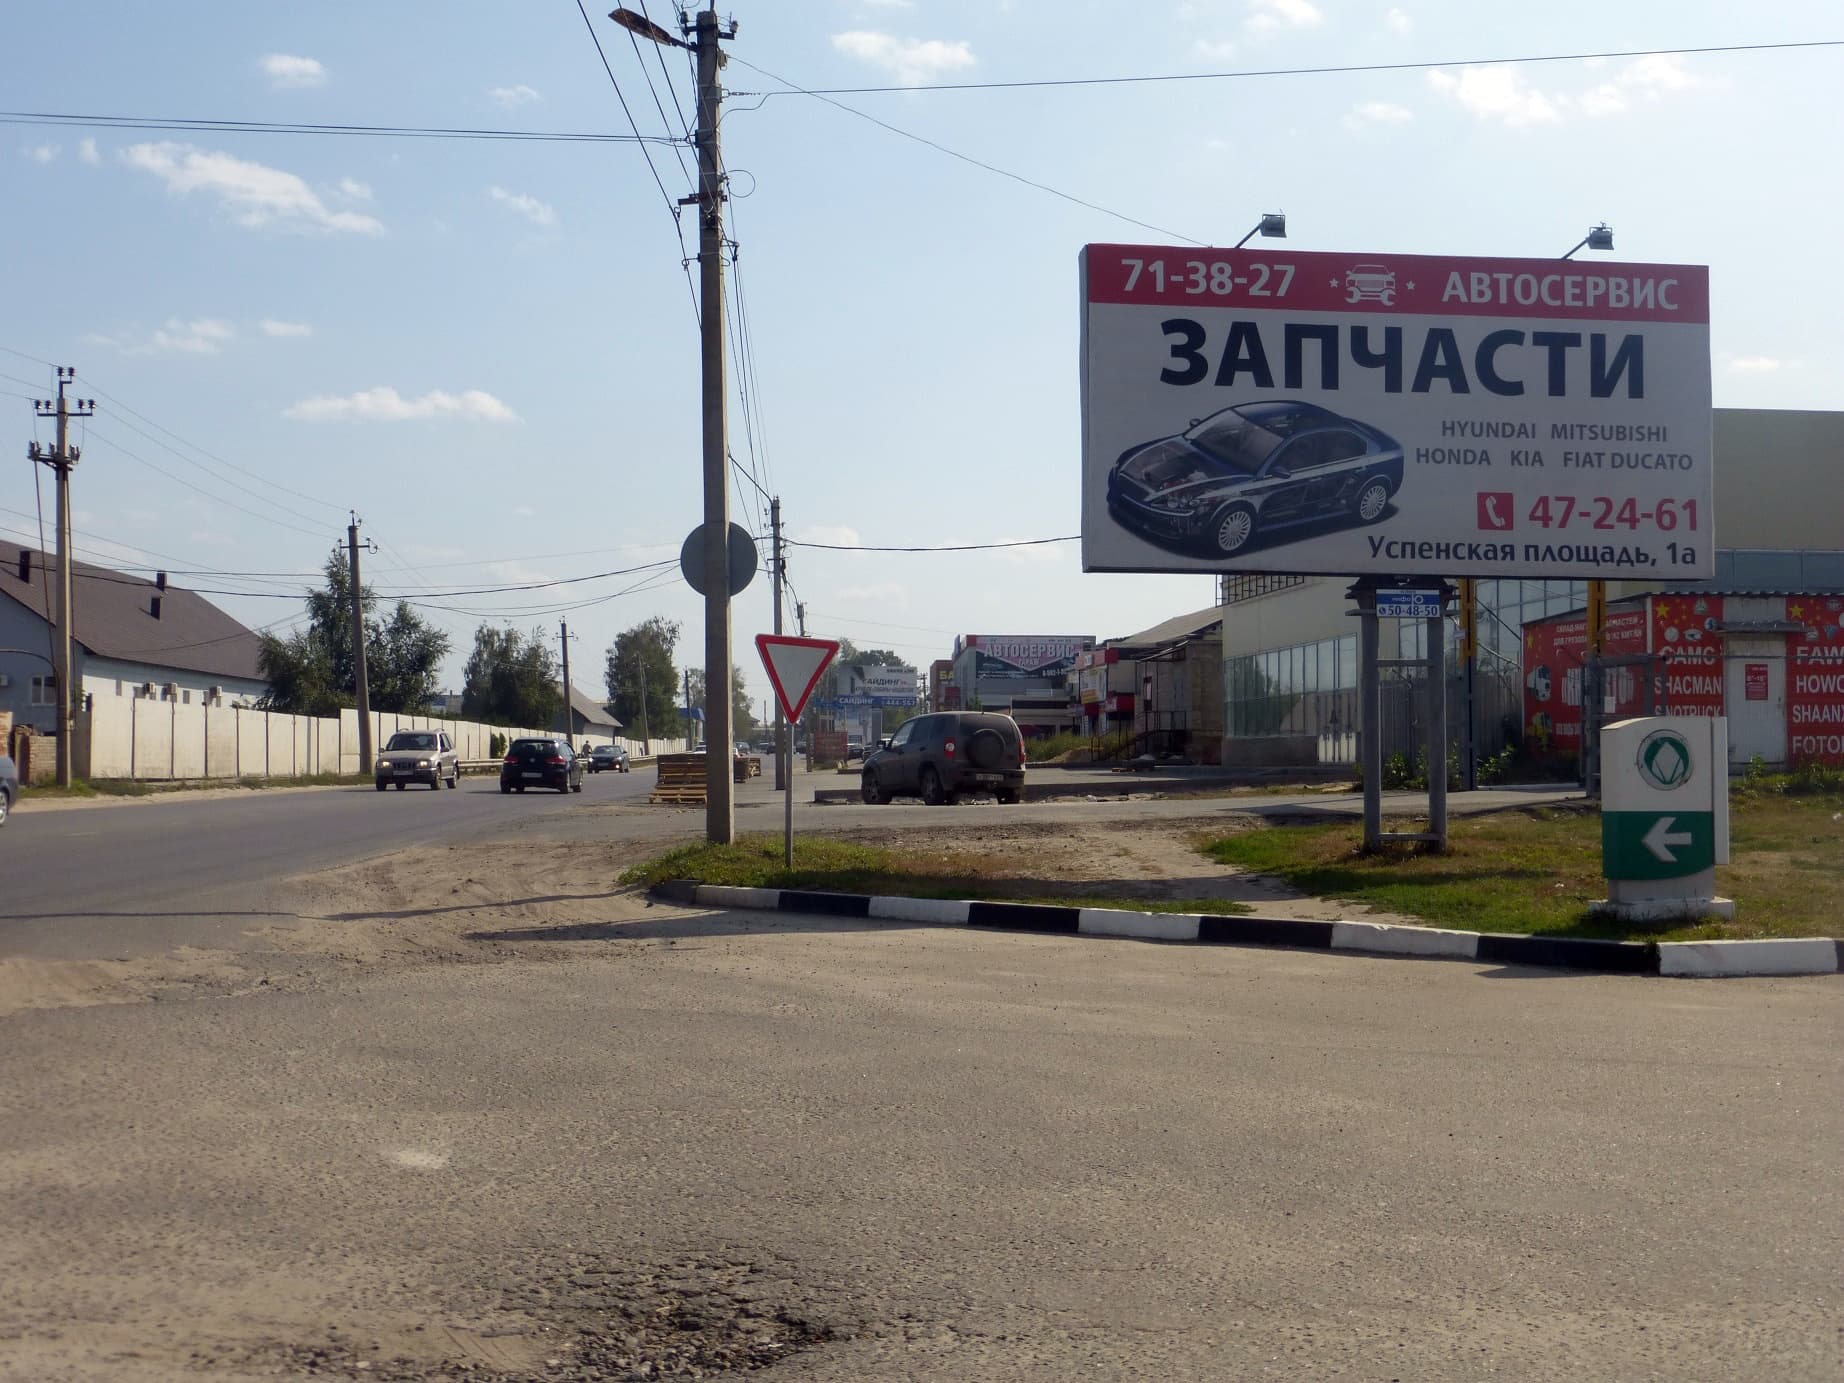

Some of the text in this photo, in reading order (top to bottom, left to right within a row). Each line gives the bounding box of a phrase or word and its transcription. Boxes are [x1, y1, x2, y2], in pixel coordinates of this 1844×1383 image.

[1120, 258, 1295, 297] 71-38-27
[1441, 271, 1680, 310] АВТОСЕРВИС
[1160, 318, 1644, 400] ЗАПЧАСТИ
[1441, 420, 1667, 442] HYUNDAI MITSUBISHI
[1415, 447, 1693, 471] HONDA KIA FIAT DUCATO
[1528, 495, 1697, 531] 47-24-61
[1368, 535, 1696, 567] Успенская площадь, 1а
[1387, 605, 1438, 616] 50-48-50
[984, 643, 1074, 657] АВТОСЕРВИС
[1796, 646, 1844, 666] FAW
[1654, 704, 1721, 717] SNOTRUCK
